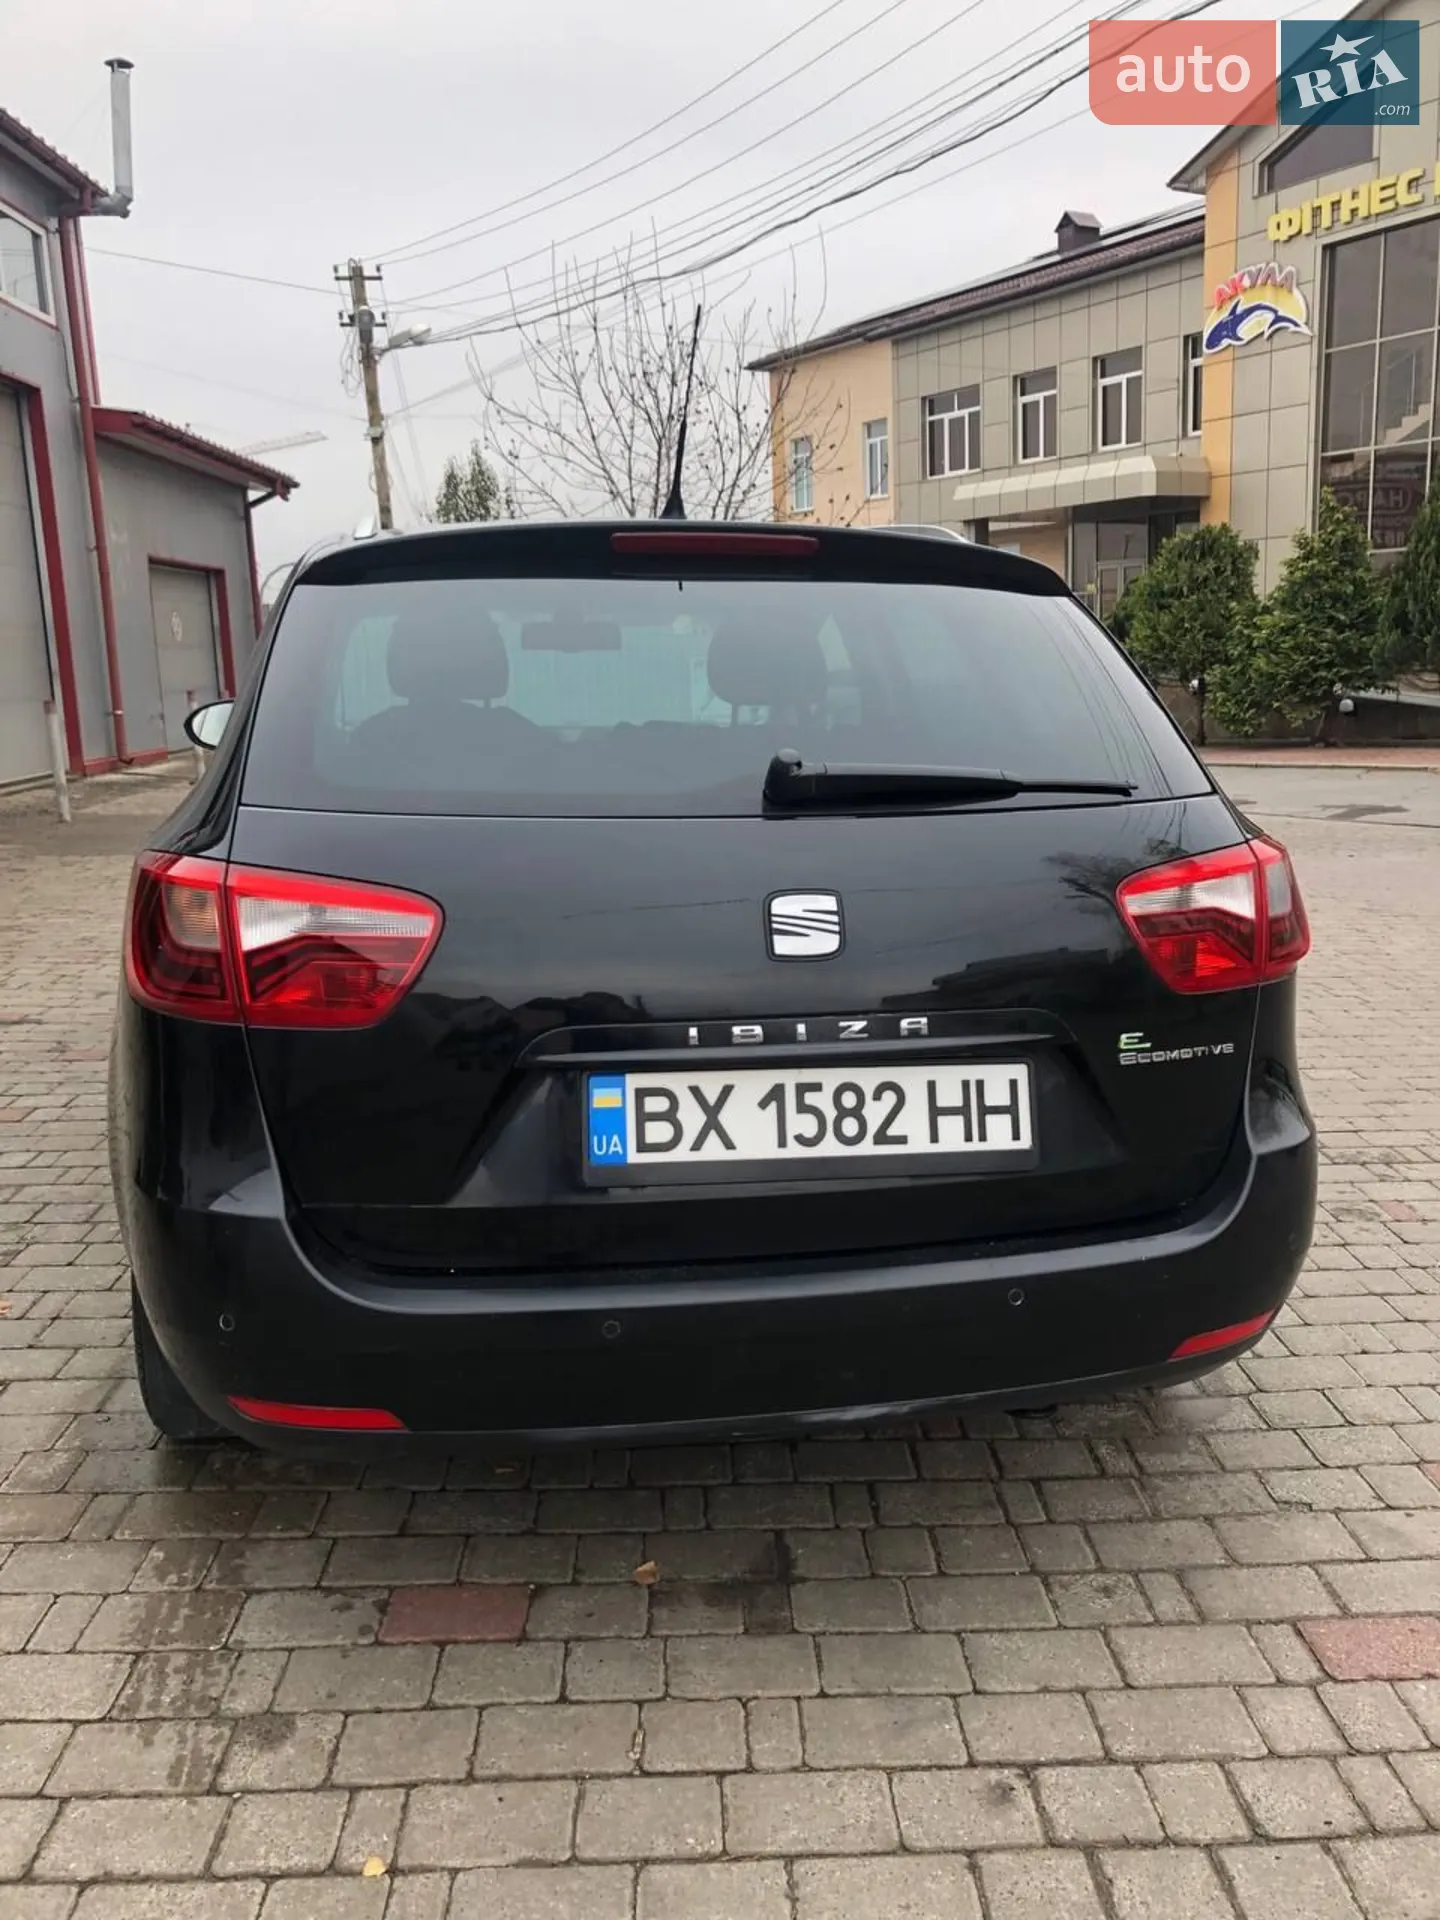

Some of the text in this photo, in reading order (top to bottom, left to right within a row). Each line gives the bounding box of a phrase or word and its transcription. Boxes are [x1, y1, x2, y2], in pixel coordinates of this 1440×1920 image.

[1267, 168, 1425, 241] ФІТНЕС
[688, 1017, 930, 1045] IBIZA
[1119, 1043, 1235, 1065] ECOMOTIVE
[634, 1078, 1021, 1153] BX 1582 HH
[593, 1136, 622, 1155] UA
